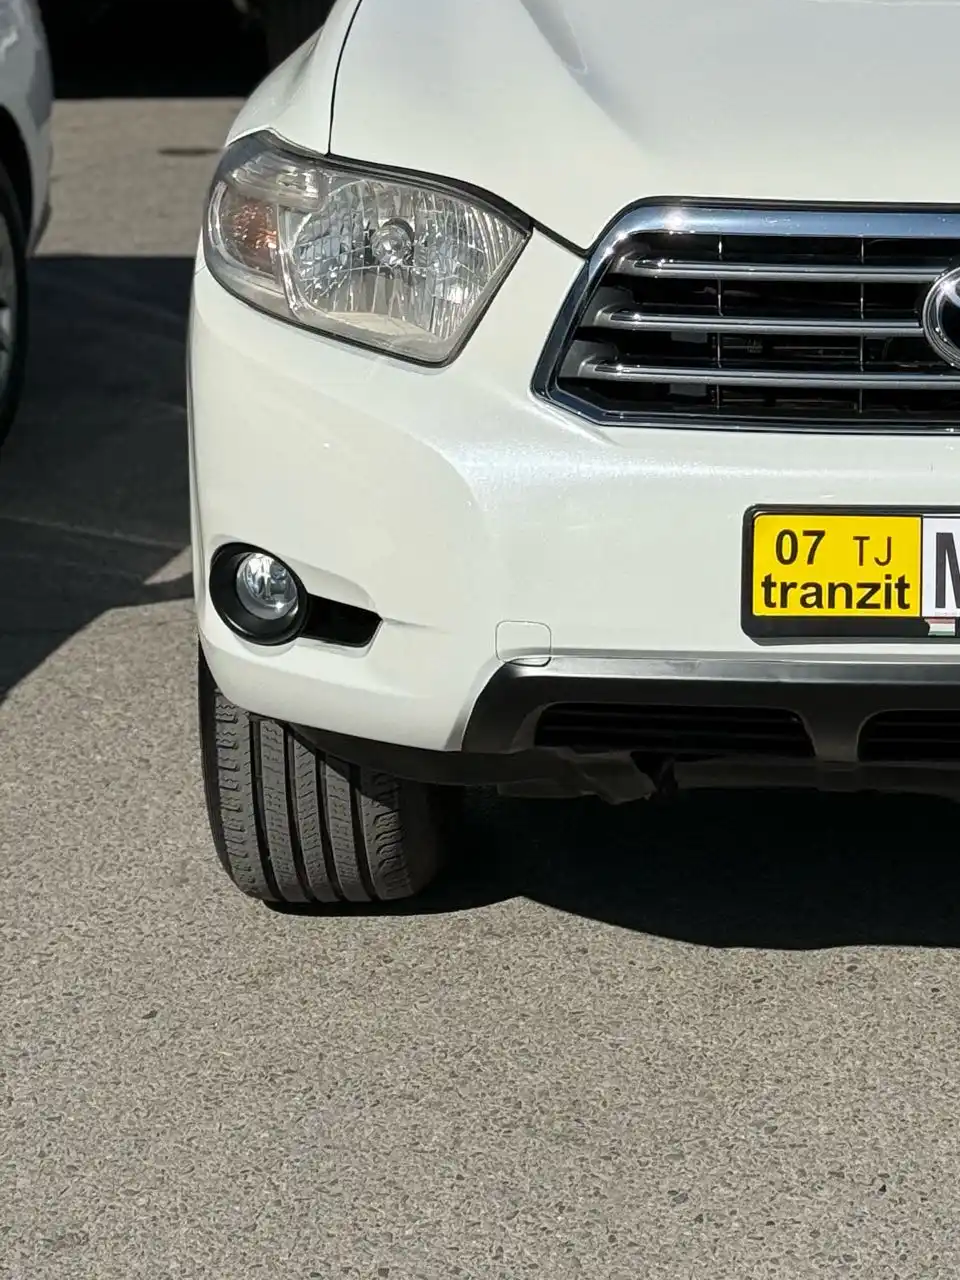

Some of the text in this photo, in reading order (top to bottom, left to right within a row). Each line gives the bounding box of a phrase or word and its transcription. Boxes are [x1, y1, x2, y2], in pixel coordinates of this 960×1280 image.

[775, 529, 892, 567] 07 TJ
[761, 573, 911, 610] tranzit
